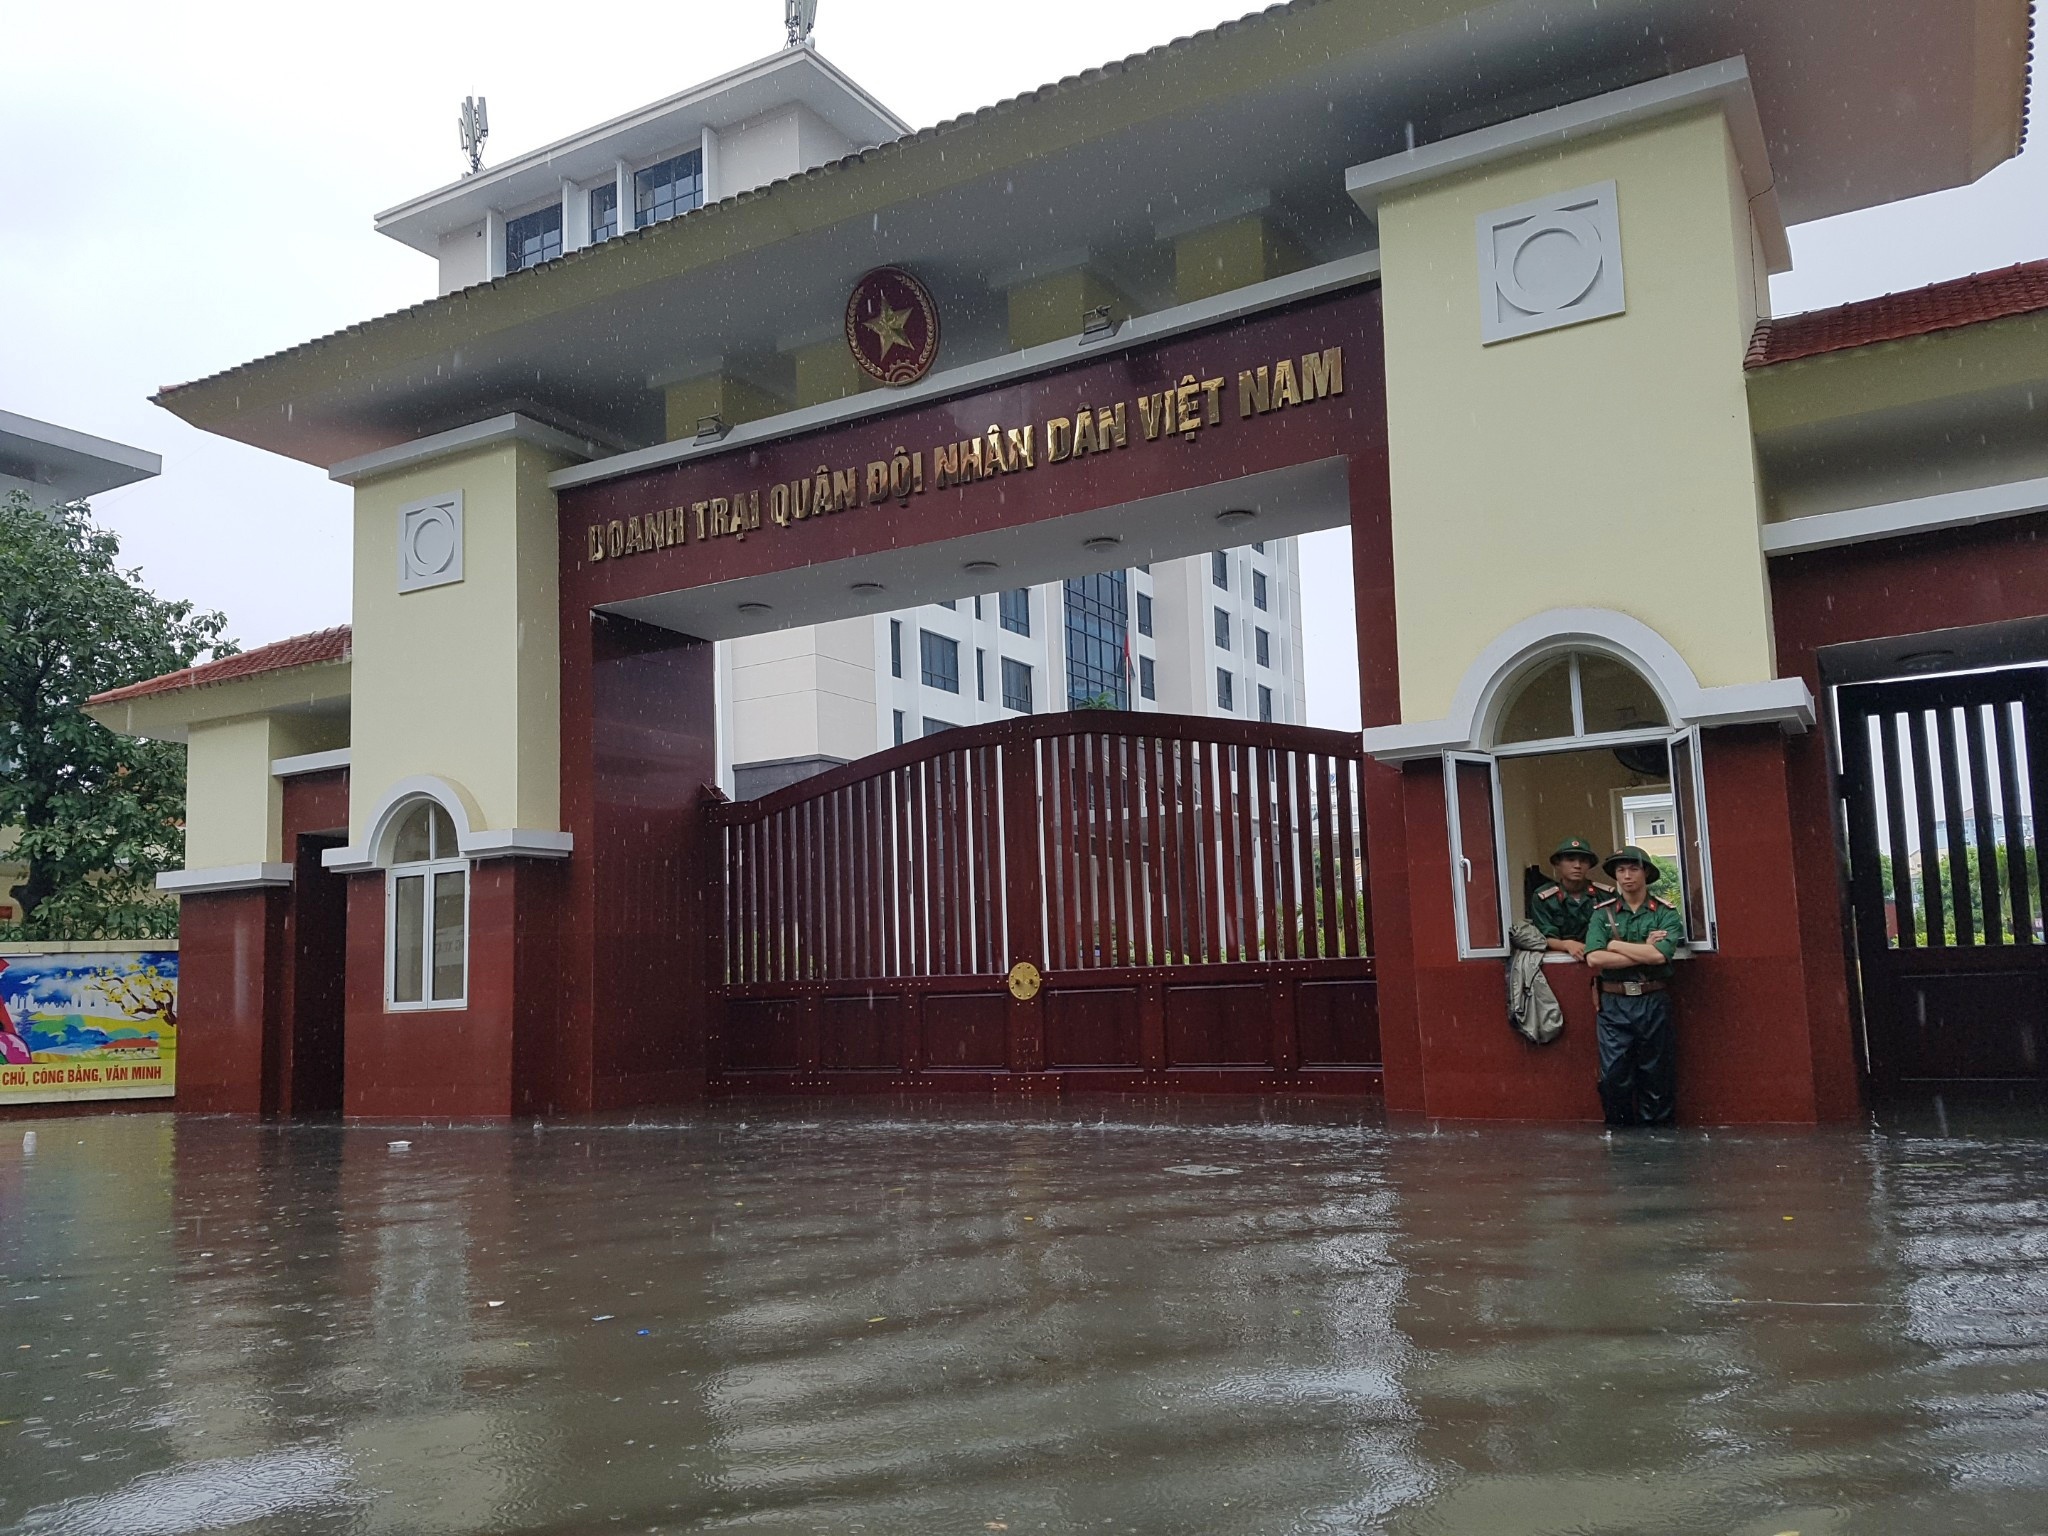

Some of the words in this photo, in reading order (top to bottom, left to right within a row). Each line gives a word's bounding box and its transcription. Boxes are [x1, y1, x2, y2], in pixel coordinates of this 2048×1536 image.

[587, 506, 685, 562] DOANH
[692, 489, 760, 541] TRẠI
[770, 465, 857, 527] QUÂN
[867, 446, 925, 506] ĐỘI
[934, 425, 1034, 488] NHÂN
[1047, 402, 1127, 463] DÂN
[1138, 375, 1225, 441] VIỆT
[1238, 346, 1343, 418] NAM
[2, 1067, 29, 1086] CHỦ,
[106, 1065, 128, 1081] VĂN
[132, 1066, 162, 1080] MINH
